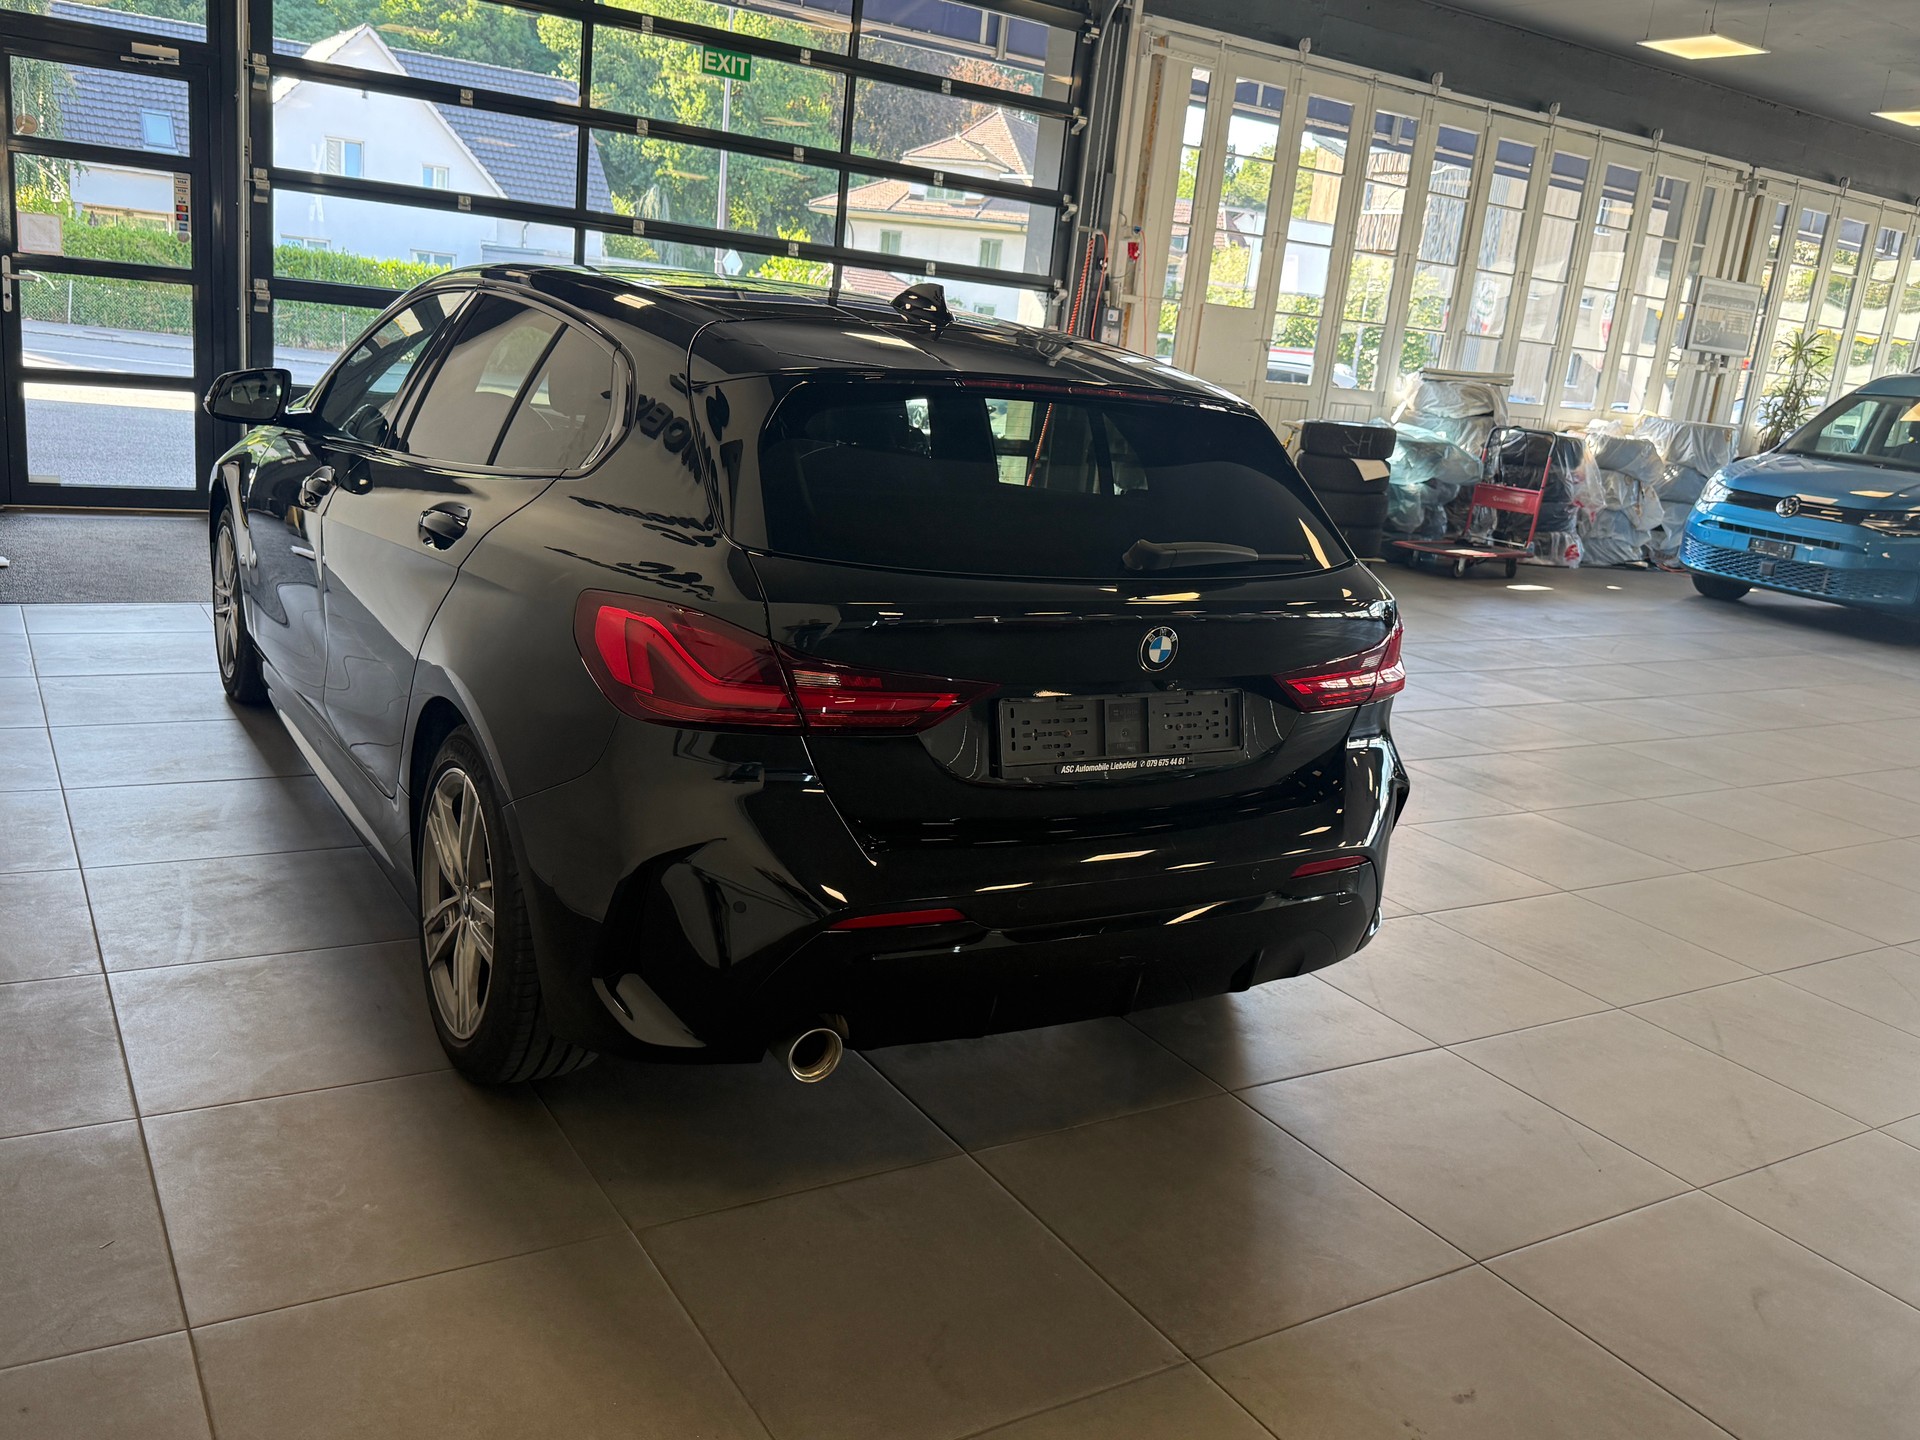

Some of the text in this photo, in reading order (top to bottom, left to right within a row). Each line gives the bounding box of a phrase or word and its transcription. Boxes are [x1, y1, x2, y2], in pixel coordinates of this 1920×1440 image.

[704, 50, 750, 77] EXIT
[1060, 757, 1186, 774] ASC Automobile Liebefeld 079 675 44 61
